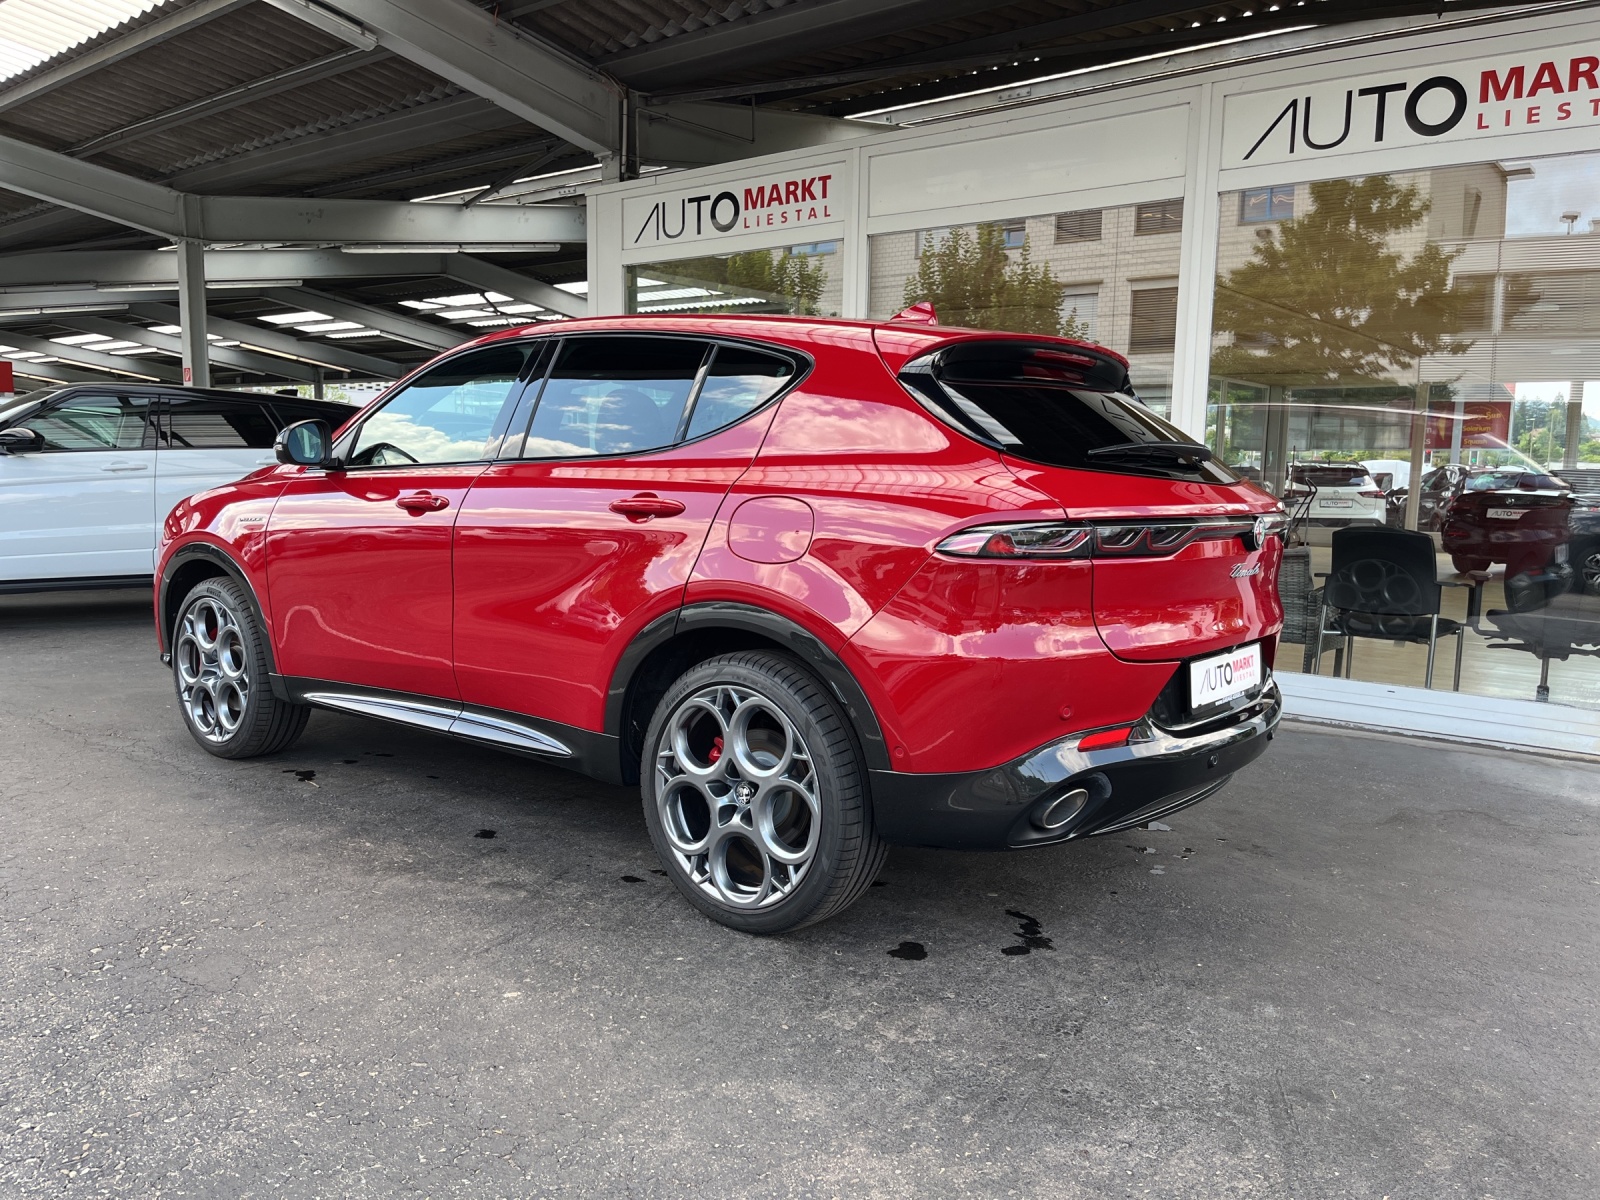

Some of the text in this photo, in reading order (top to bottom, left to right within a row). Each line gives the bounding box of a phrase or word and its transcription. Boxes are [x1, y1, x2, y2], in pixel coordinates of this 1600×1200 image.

[1242, 75, 1468, 160] AUTO
[634, 175, 832, 244] AUTO MARKT
[744, 205, 831, 229] LIESTAL
[1200, 655, 1254, 695] AUTO MARKT
